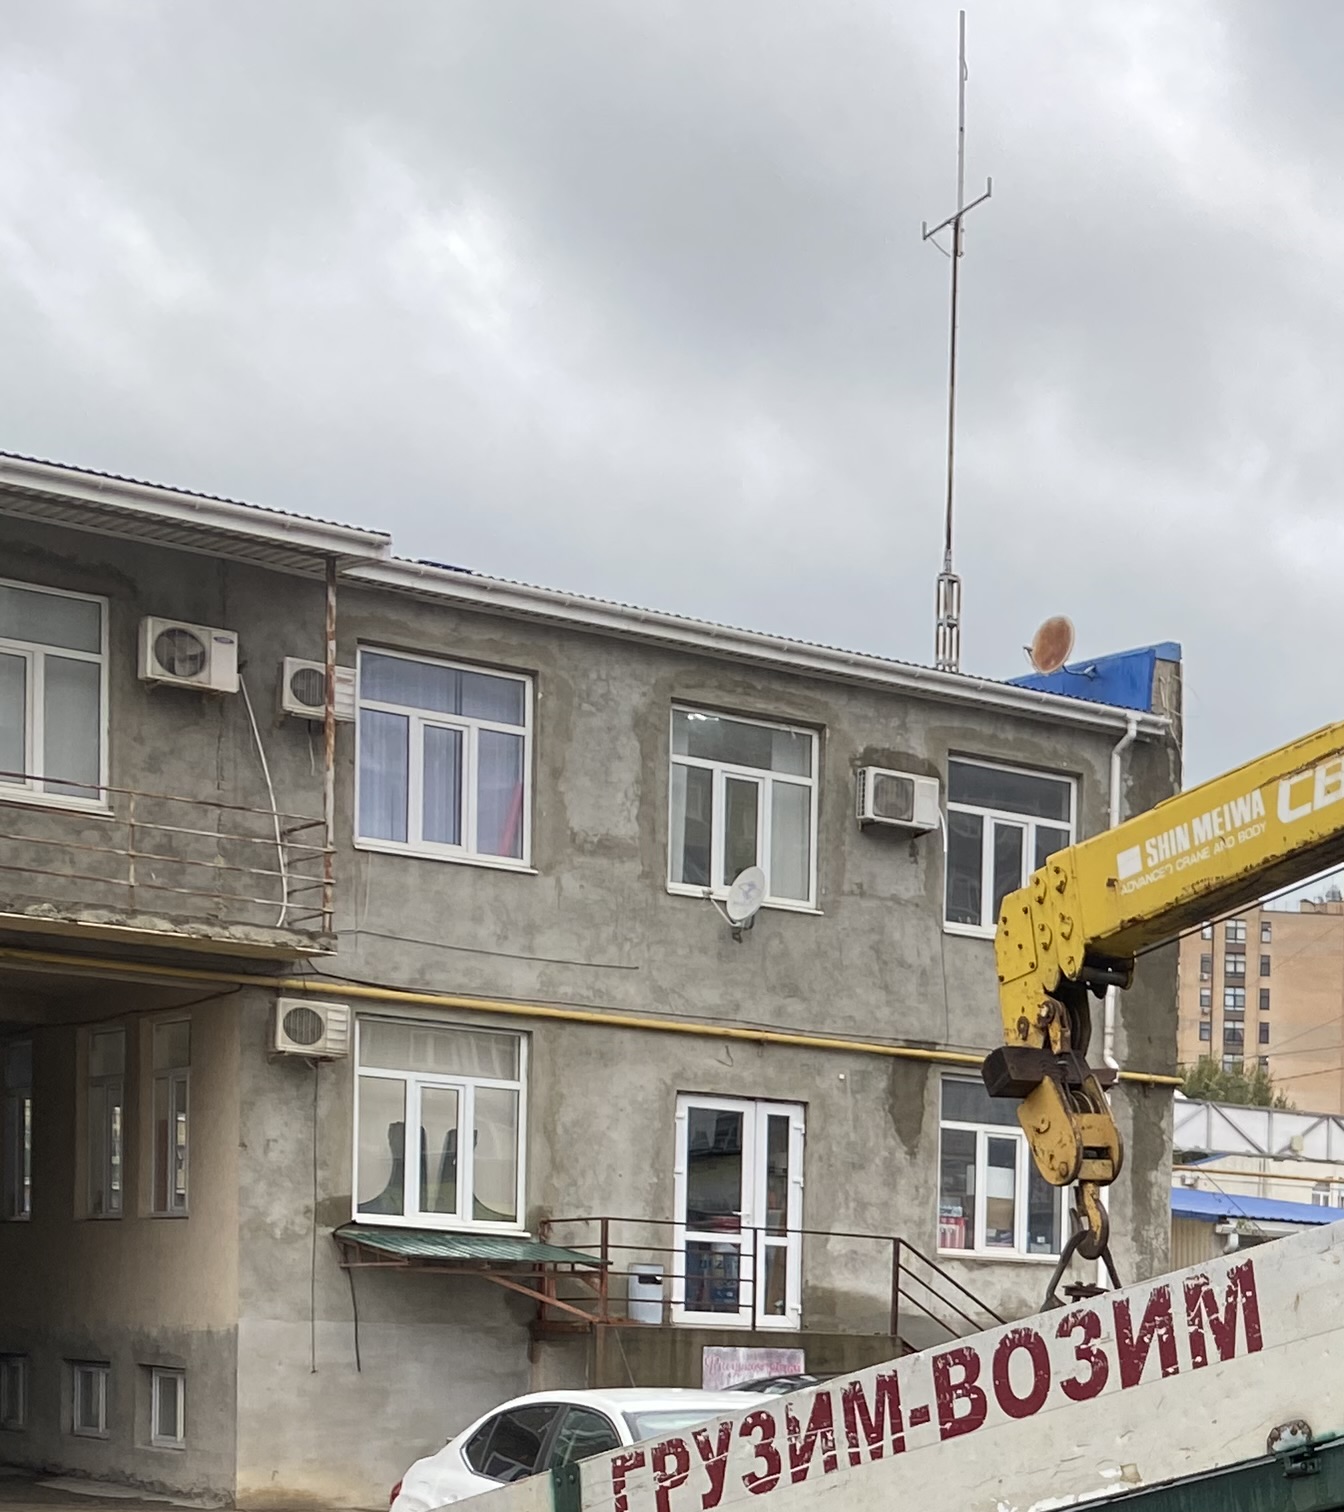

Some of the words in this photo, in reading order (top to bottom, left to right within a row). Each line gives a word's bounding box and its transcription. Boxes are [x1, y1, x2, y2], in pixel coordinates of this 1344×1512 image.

[1145, 823, 1191, 867] SHIN
[1192, 788, 1266, 846] MEIWA
[1176, 847, 1211, 871] CRANE
[1214, 836, 1235, 851] AND
[1238, 822, 1267, 843] BODY
